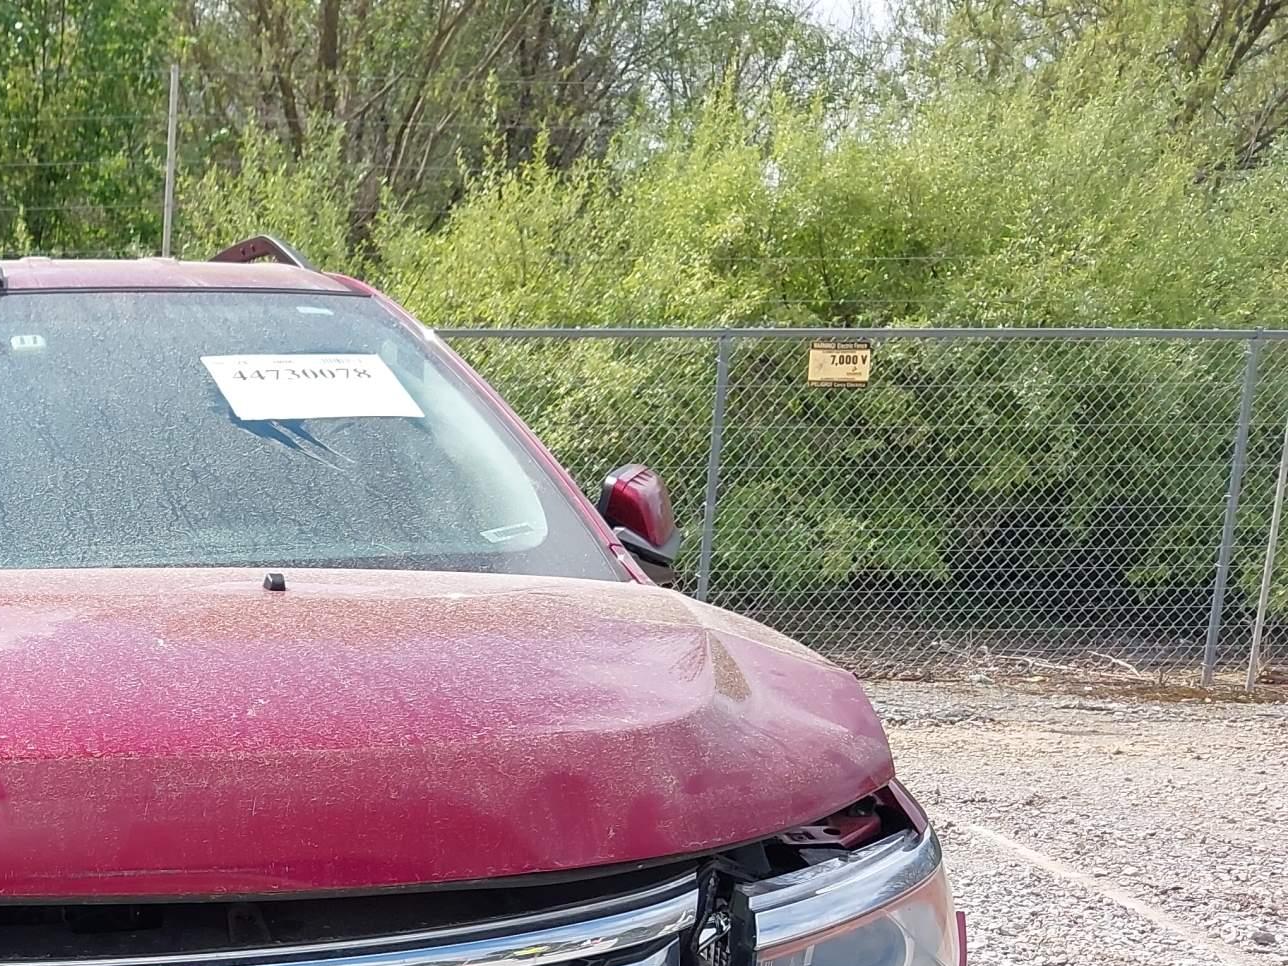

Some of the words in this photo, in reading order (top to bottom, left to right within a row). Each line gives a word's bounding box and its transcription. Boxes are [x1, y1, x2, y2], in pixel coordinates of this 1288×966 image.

[830, 354, 858, 367] 7,000
[861, 354, 868, 365] V
[232, 367, 372, 381] 44730078
